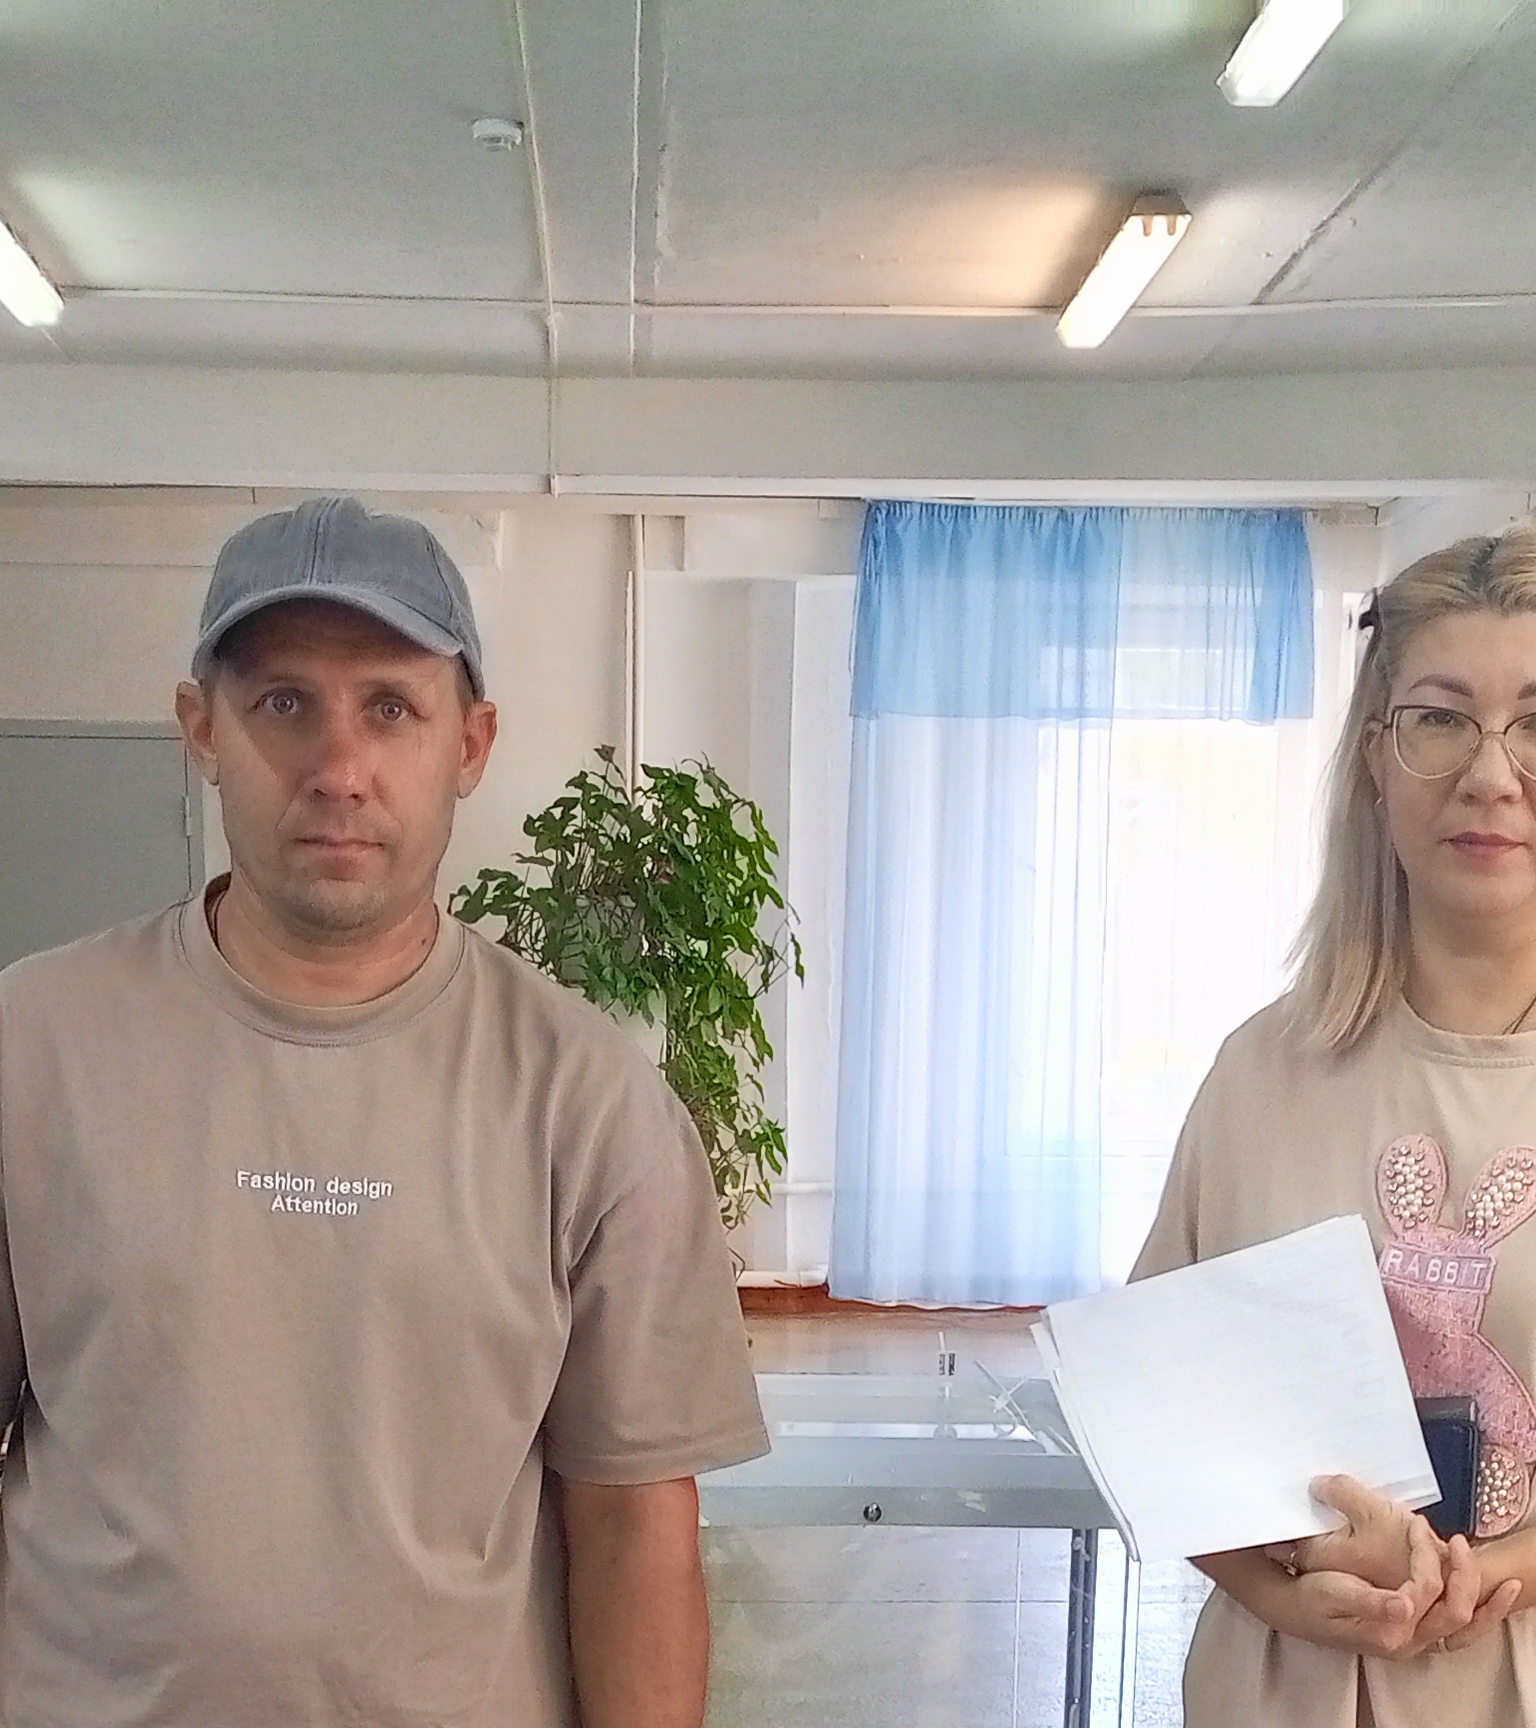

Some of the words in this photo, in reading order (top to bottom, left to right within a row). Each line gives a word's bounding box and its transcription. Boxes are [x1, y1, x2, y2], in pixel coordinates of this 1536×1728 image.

[235, 1169, 316, 1194] Fashion
[325, 1174, 395, 1201] design
[269, 1193, 360, 1217] Attention
[1383, 1248, 1489, 1287] RABBIT
